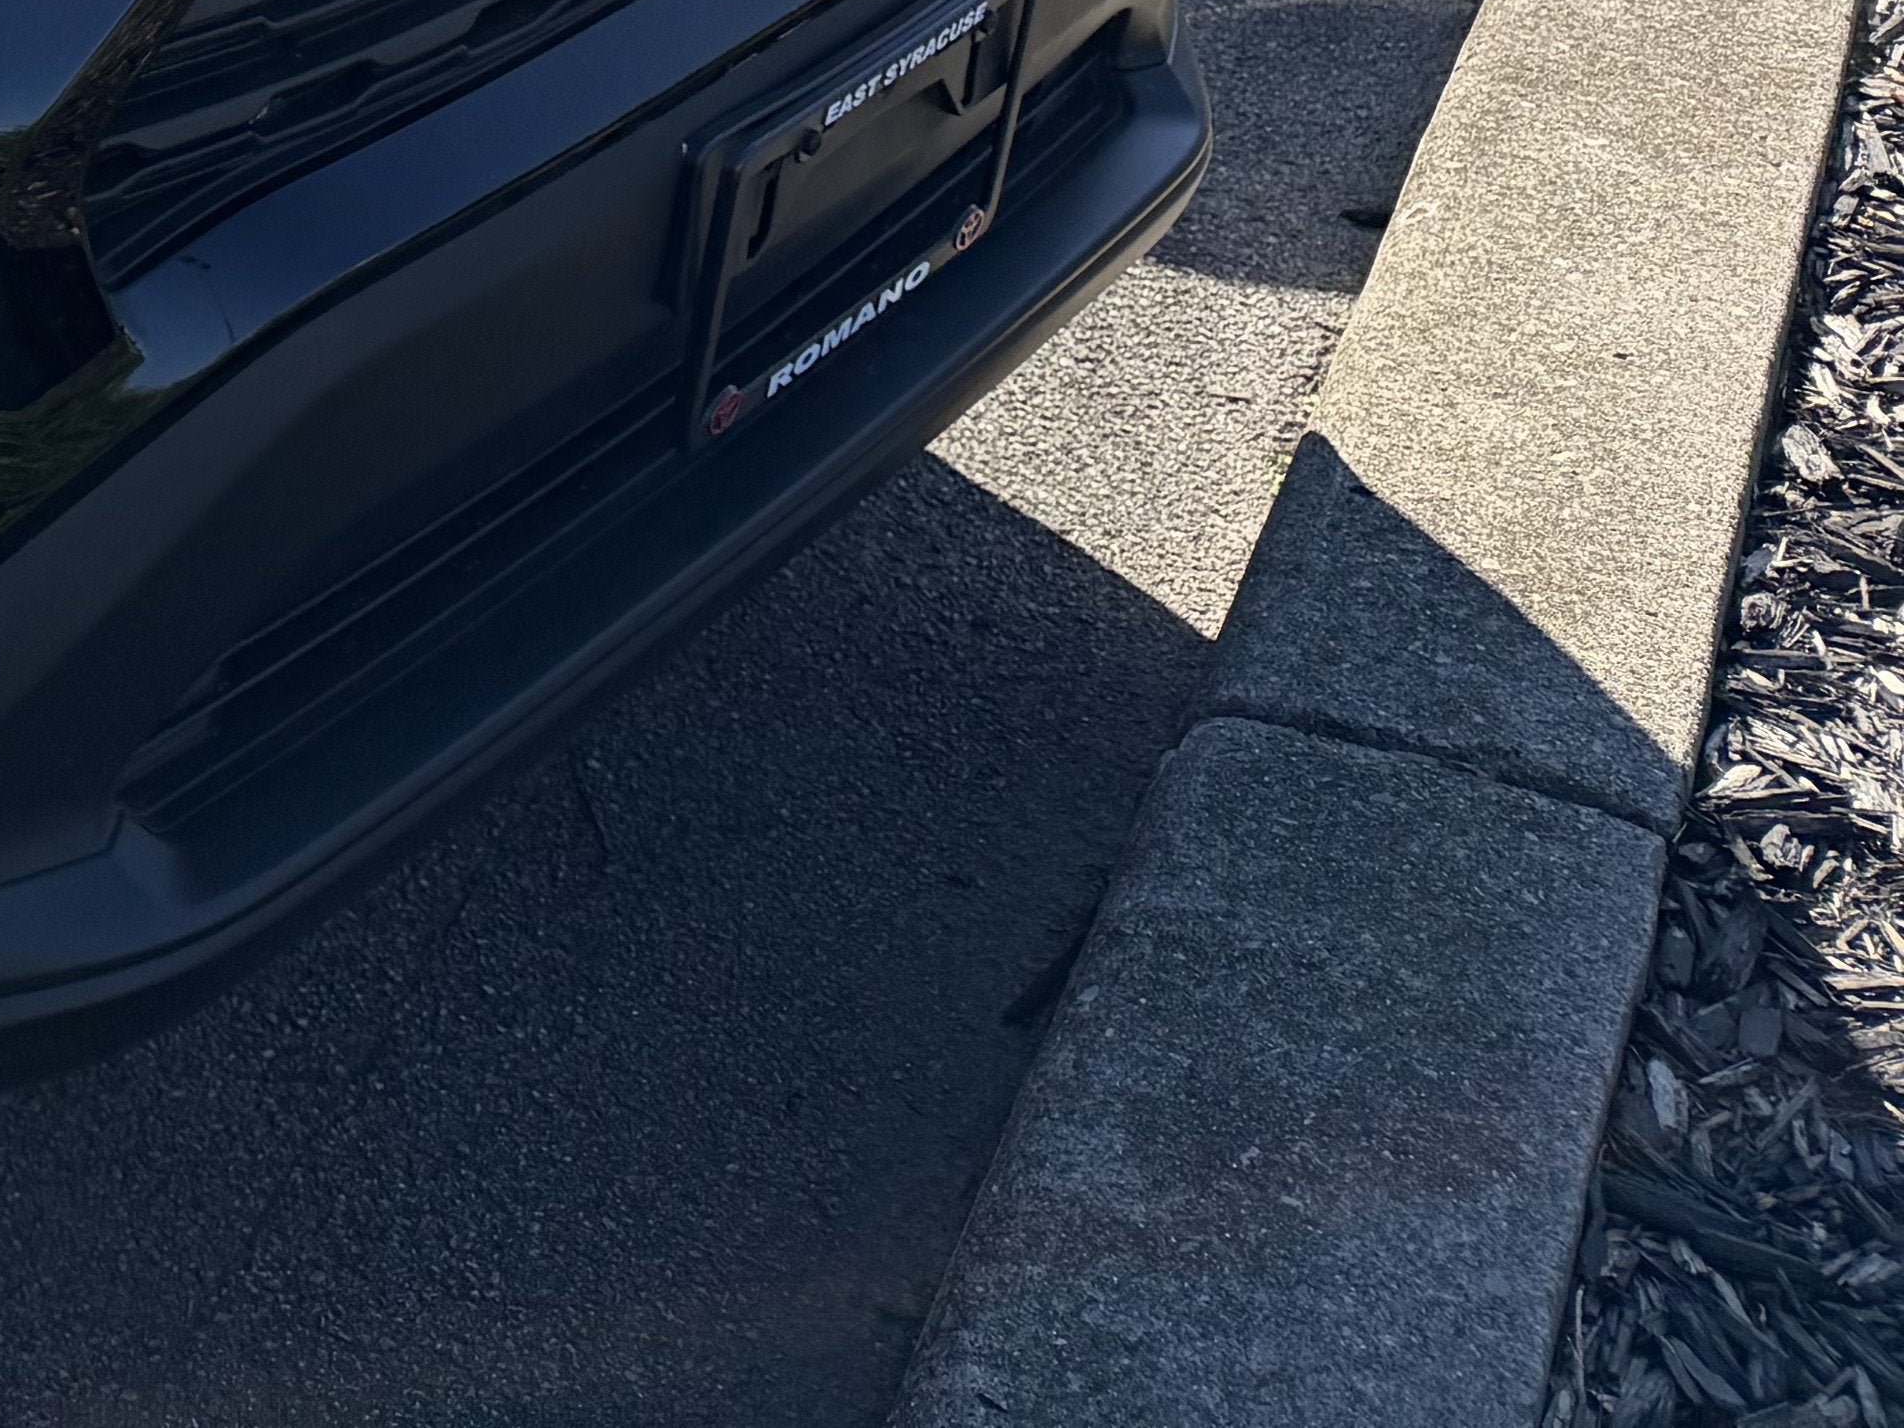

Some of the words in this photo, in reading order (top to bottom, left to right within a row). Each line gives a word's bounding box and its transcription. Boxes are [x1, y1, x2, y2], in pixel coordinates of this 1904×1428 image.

[824, 73, 882, 127] EAST
[883, 1, 989, 86] SYRACUSE
[766, 260, 931, 399] ROMANO
